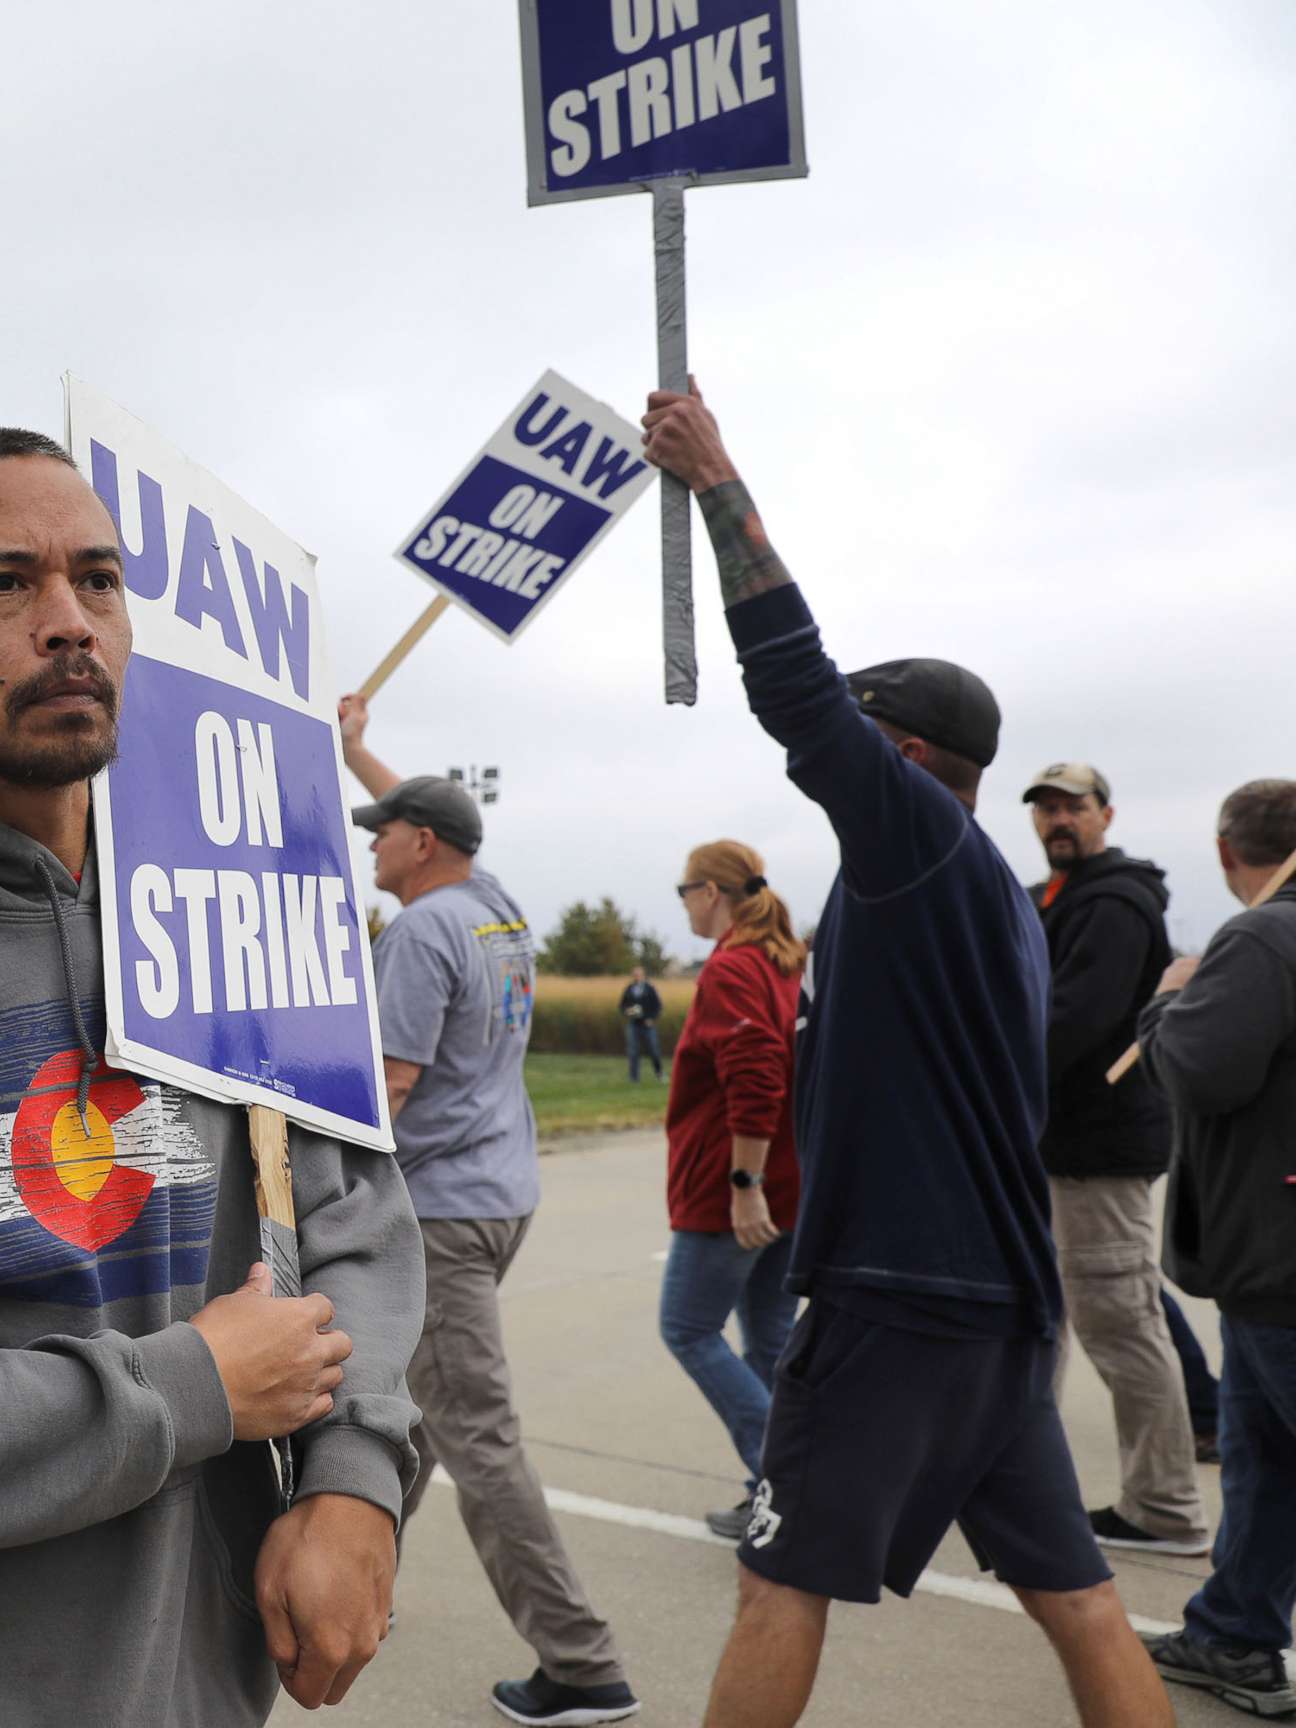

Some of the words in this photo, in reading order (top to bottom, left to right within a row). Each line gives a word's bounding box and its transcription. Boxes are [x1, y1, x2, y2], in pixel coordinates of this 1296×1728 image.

[548, 13, 776, 177] STRIKE
[488, 484, 565, 540] ON
[514, 392, 648, 500] UAW
[90, 437, 309, 703] UAW
[413, 515, 565, 601] STRIKE
[195, 711, 283, 848] ON
[130, 864, 358, 1019] STRIKE
